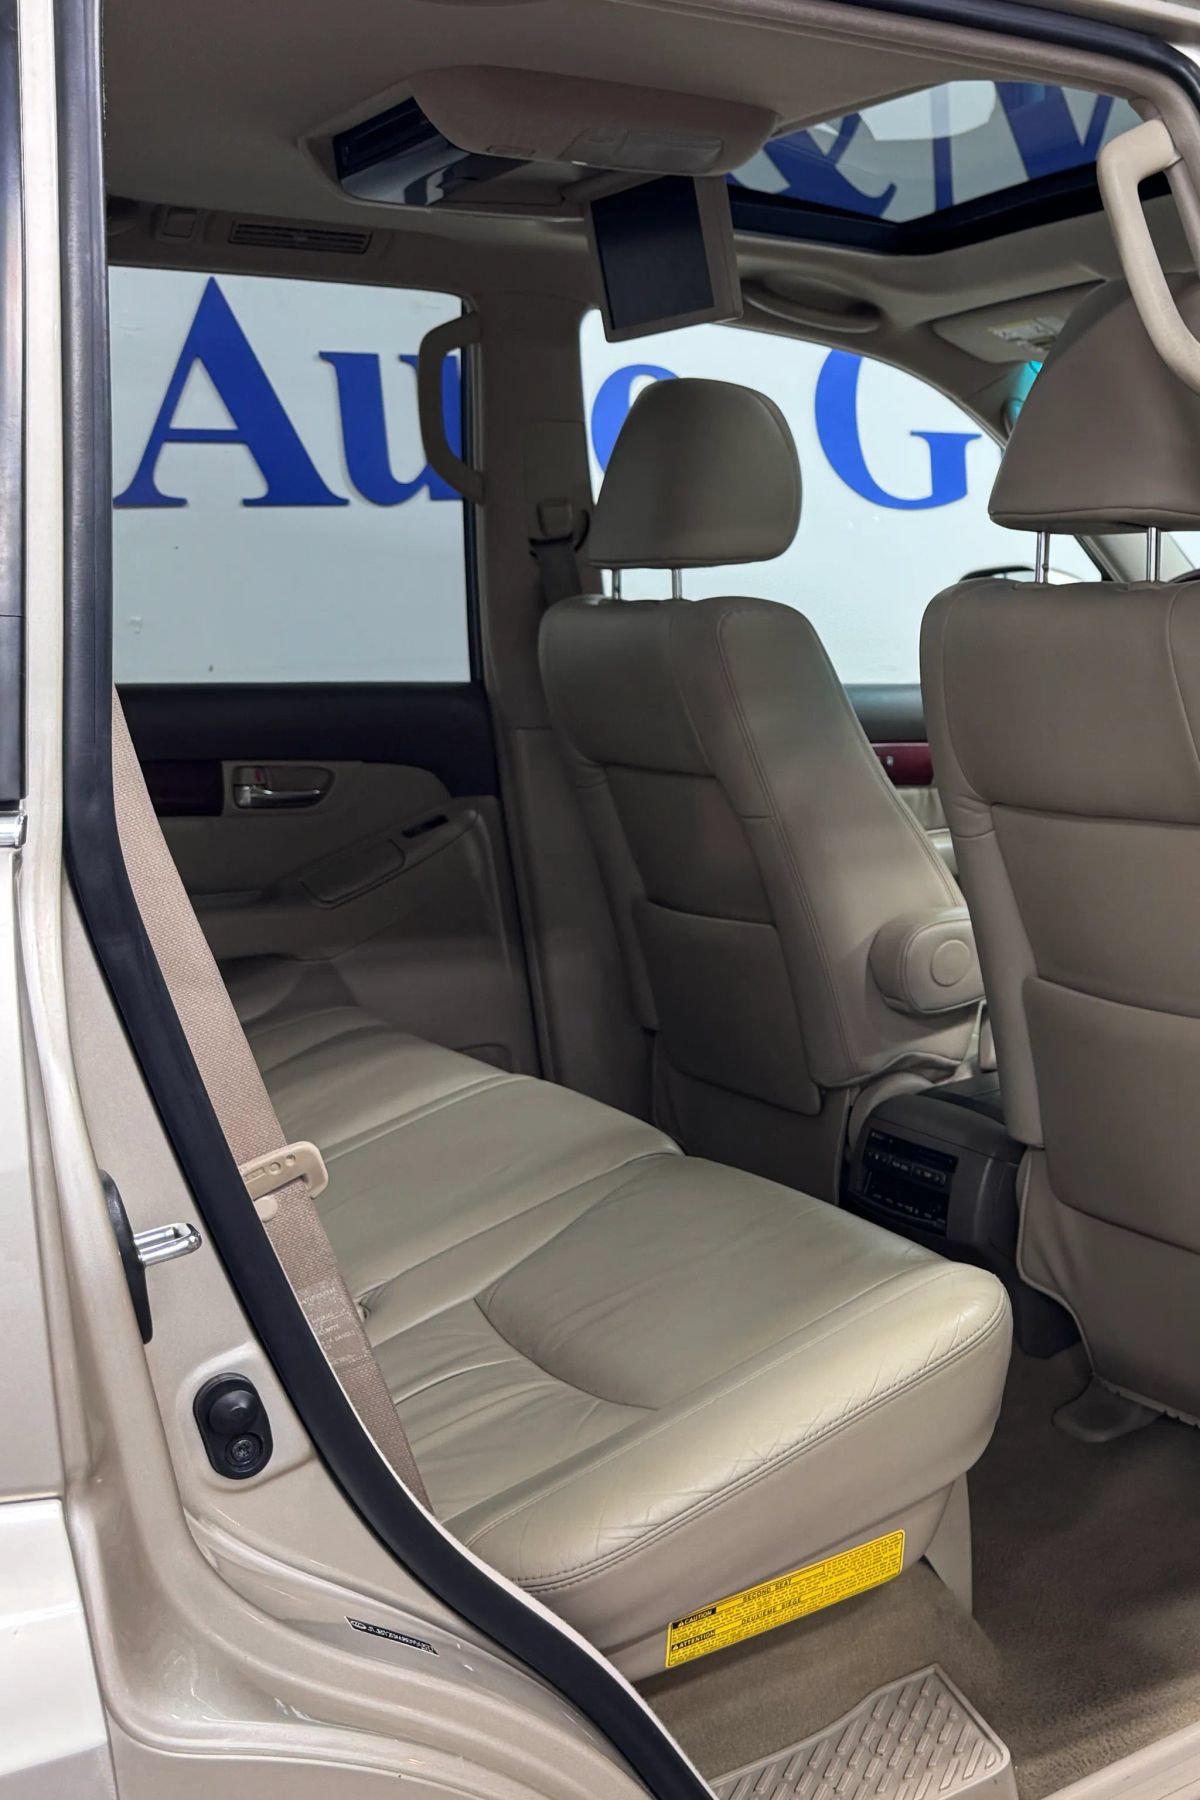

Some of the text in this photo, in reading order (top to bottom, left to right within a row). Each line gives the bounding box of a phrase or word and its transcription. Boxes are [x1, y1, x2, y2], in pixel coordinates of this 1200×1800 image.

[684, 1579, 792, 1625] CAUTION SECOND SEAT
[679, 1630, 716, 1649] ATTENTION
